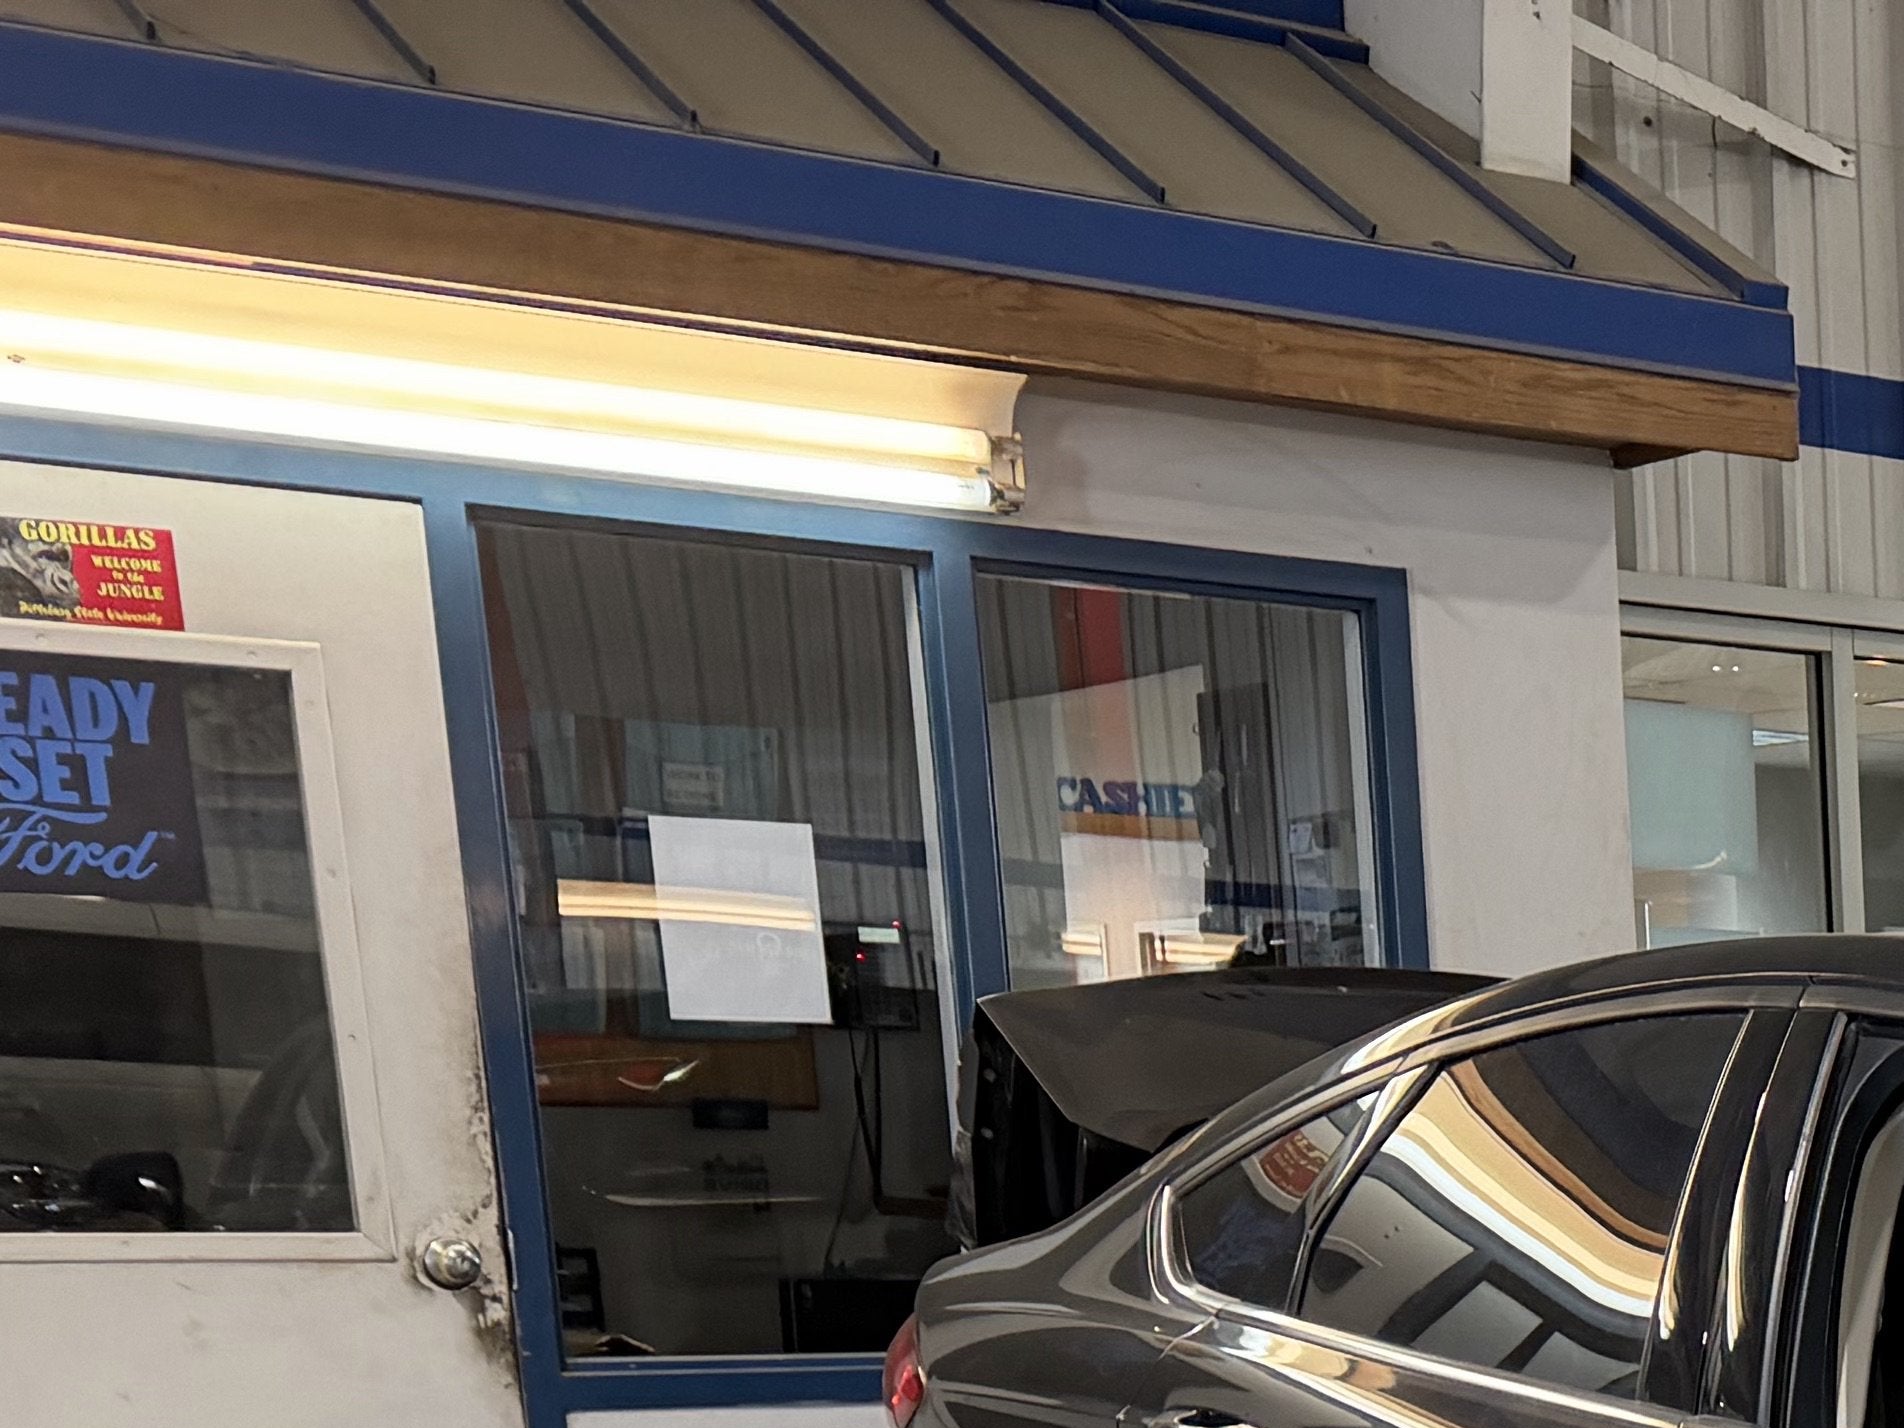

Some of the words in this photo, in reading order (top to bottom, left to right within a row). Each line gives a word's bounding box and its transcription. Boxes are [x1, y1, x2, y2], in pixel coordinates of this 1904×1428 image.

[18, 519, 157, 551] GORILLAS
[91, 554, 162, 573] WELCOME
[96, 582, 164, 601] JUNGLE
[0, 671, 155, 745] EADY
[0, 735, 113, 806] SET
[1057, 775, 1198, 819] CASHIE
